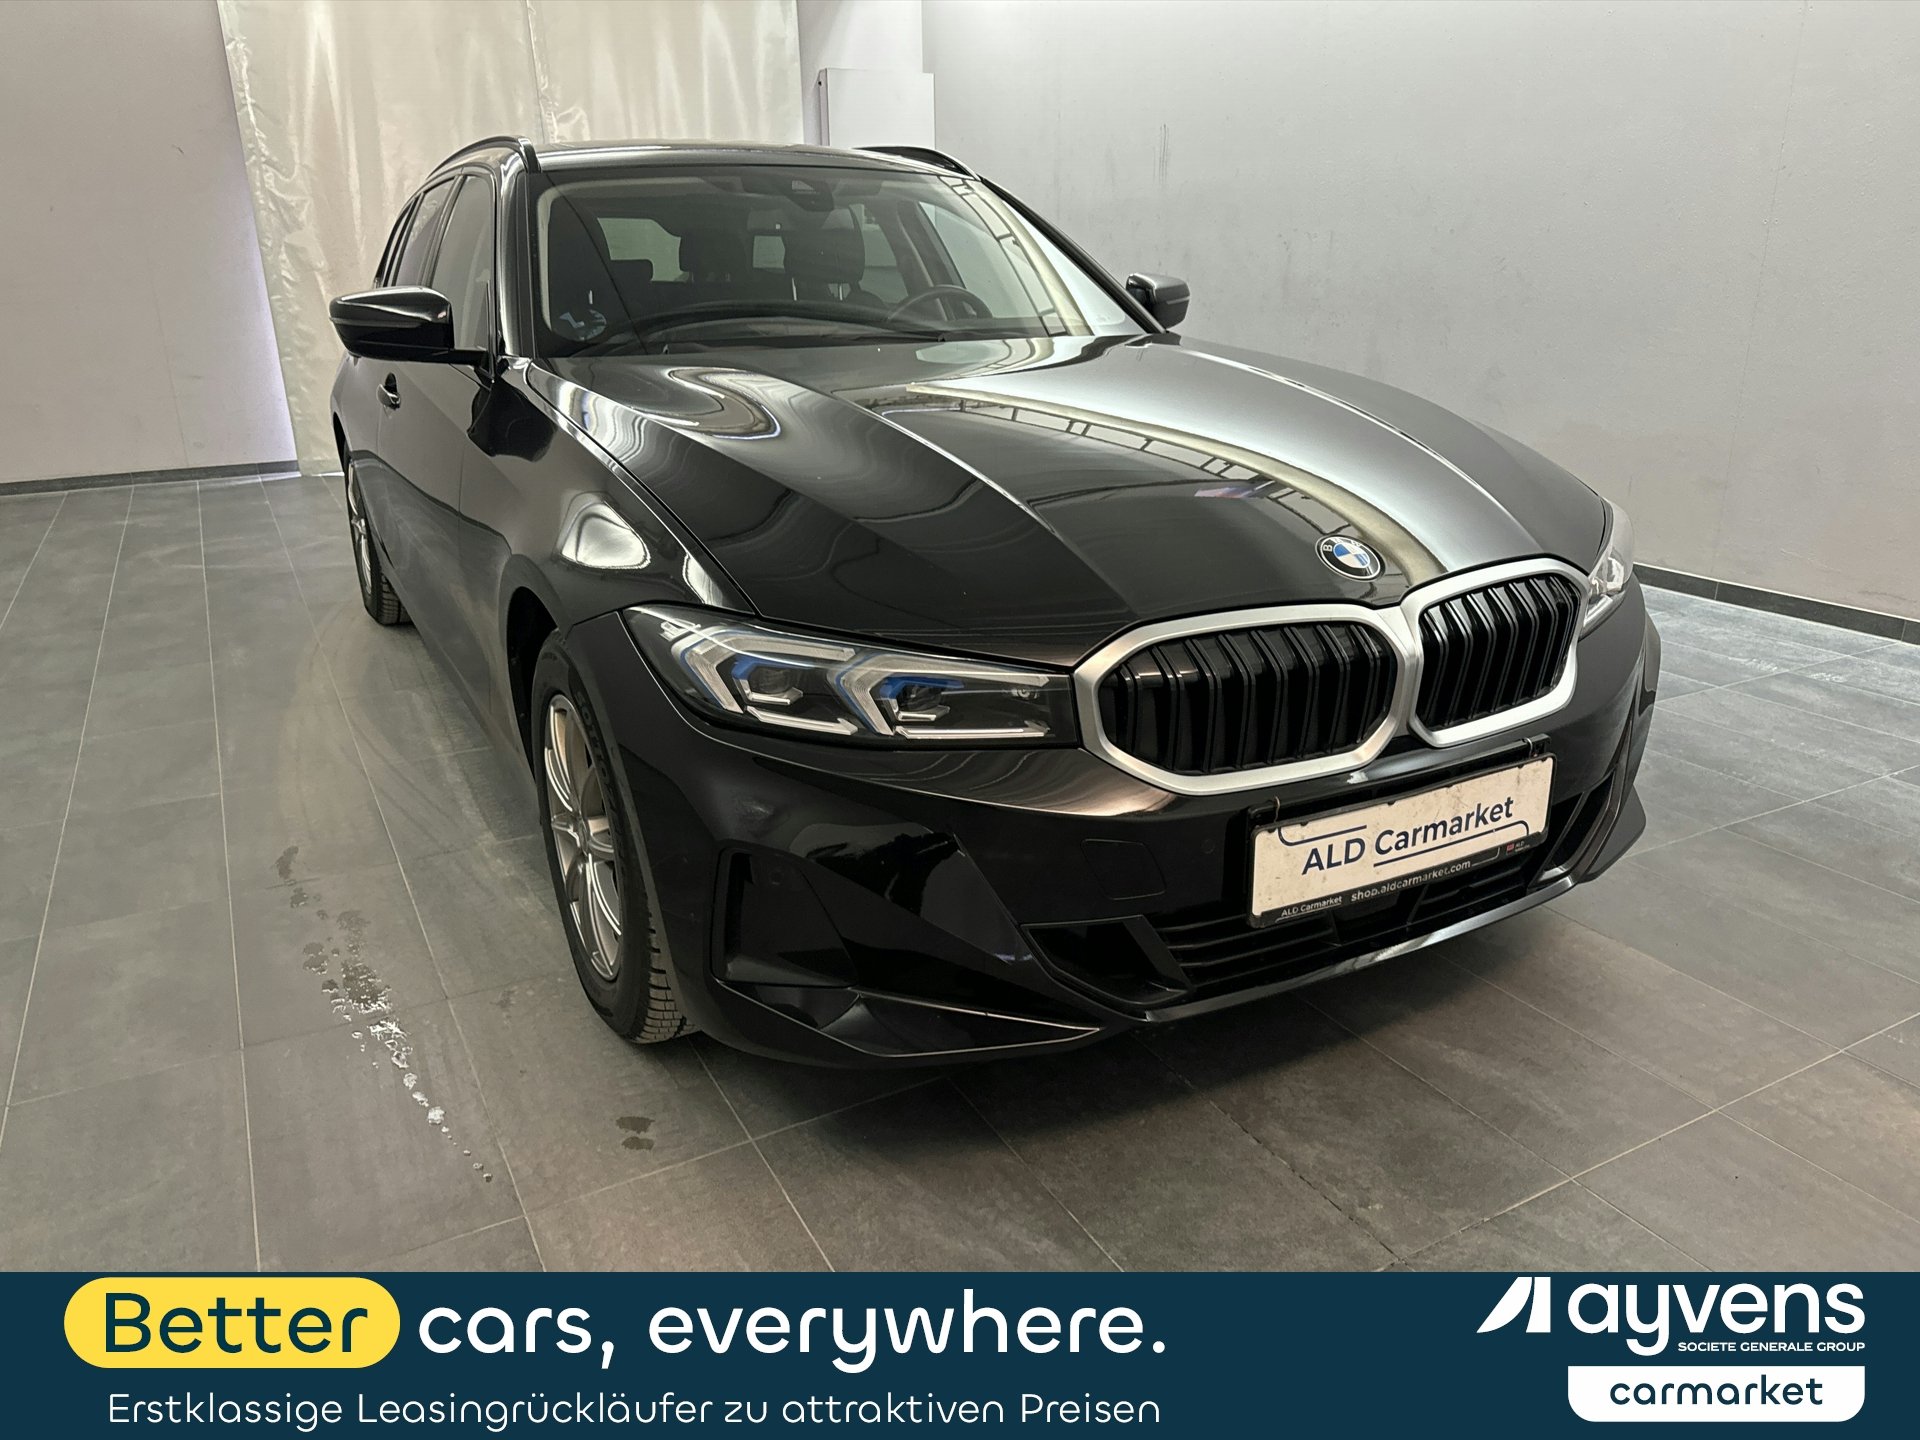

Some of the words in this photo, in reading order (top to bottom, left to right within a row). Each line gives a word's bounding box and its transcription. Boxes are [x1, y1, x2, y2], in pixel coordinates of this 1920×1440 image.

[1301, 837, 1366, 876] ALD
[1374, 796, 1514, 856] Carmarket
[1281, 905, 1300, 918] ALD
[1300, 895, 1343, 913] Carmarket
